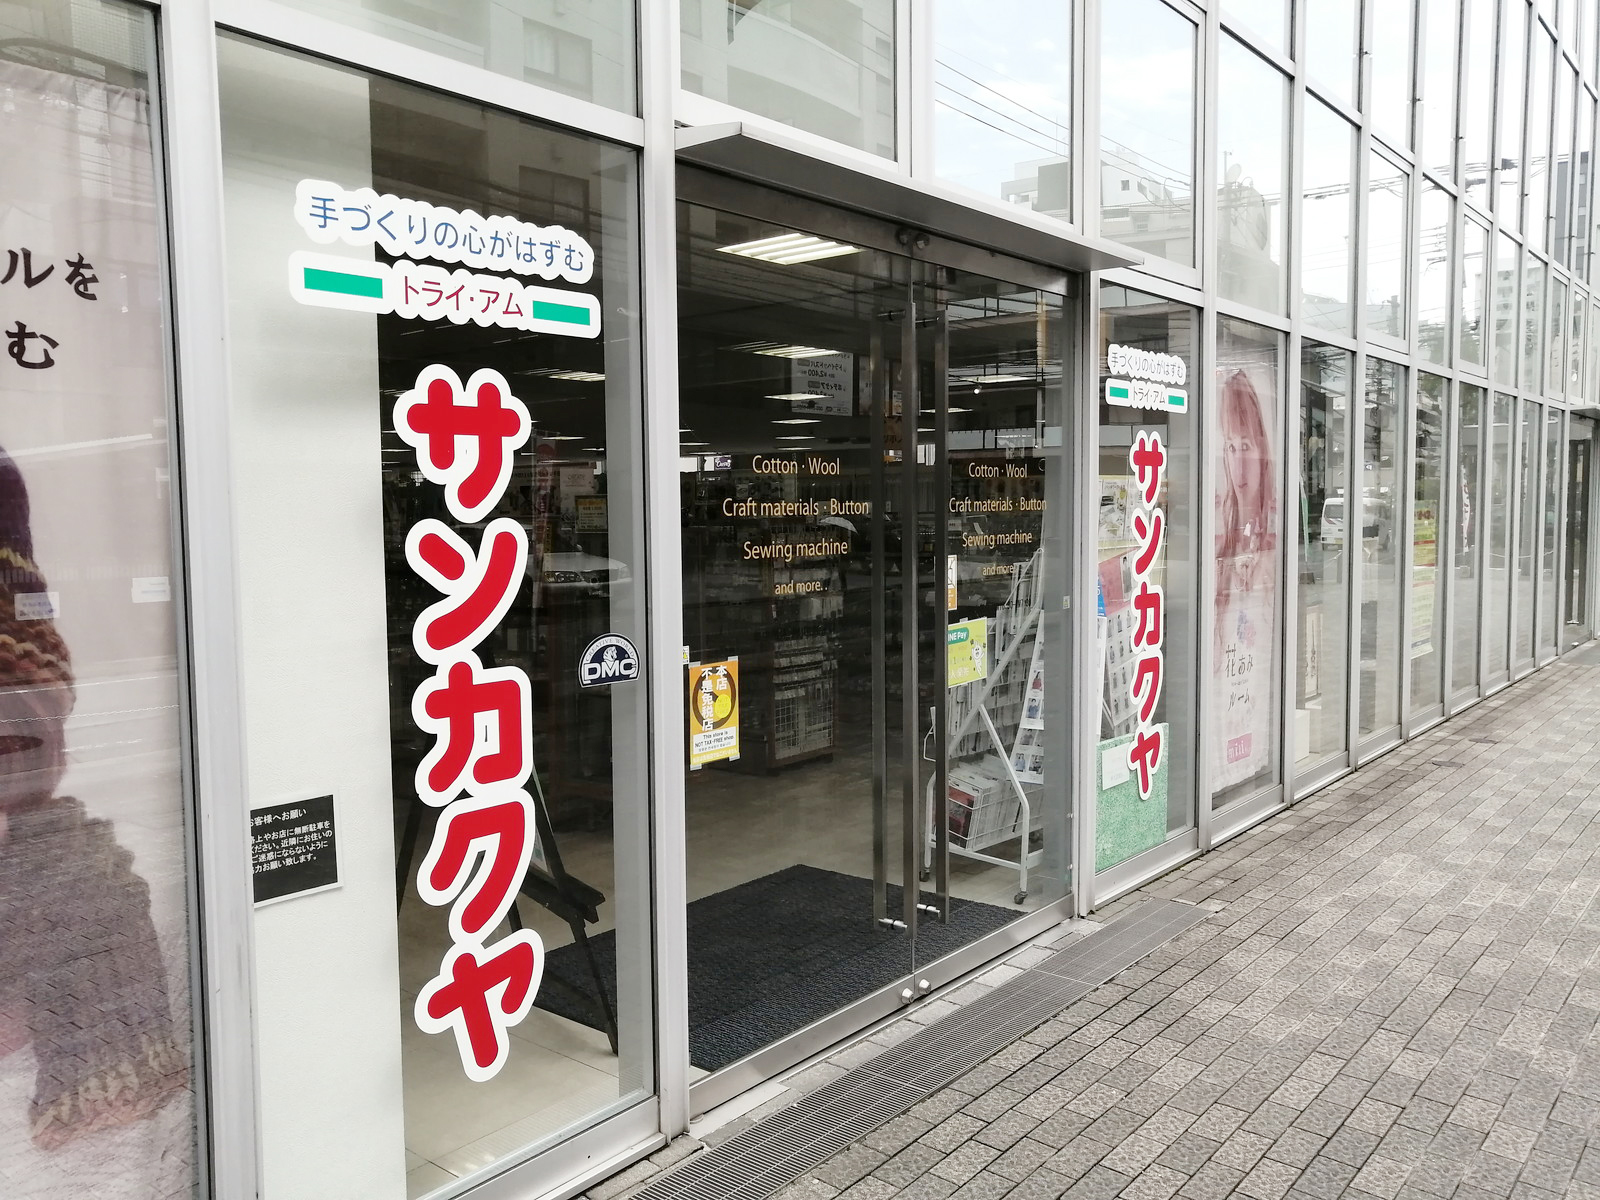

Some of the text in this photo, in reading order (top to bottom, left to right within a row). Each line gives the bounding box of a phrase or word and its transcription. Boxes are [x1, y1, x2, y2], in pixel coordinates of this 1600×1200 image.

[308, 195, 584, 272] 手づくりの心がはずむ
[0, 247, 99, 301] ルを
[404, 275, 524, 318] トライ・アム
[5, 320, 60, 370] む
[1111, 352, 1183, 378] 手づくりの心がはずむ
[752, 455, 798, 474] Cotton
[808, 457, 840, 475] Wool
[968, 462, 1028, 478] Cotton Wool
[722, 497, 869, 517] Craft materials Button
[949, 496, 1047, 512] Craft materials Button
[743, 538, 848, 562] Sewing machine
[962, 529, 1033, 549] Sewing machine
[982, 564, 996, 576] and
[774, 580, 794, 595] and
[1130, 437, 1164, 794] サンカクヤ
[948, 631, 967, 642] INE Pay
[586, 639, 612, 661] CREATIVE
[1225, 643, 1253, 678] 花あみ
[584, 659, 637, 681] DMC
[715, 665, 728, 691] 本店
[701, 667, 714, 732] 不是免税店
[1228, 688, 1250, 711] ルーム
[405, 377, 536, 1069] サンカクヤ
[695, 740, 704, 748] NOT
[704, 737, 723, 746] TAX-FREE
[713, 731, 724, 739] store
[252, 853, 317, 874] 力お願い致します。
